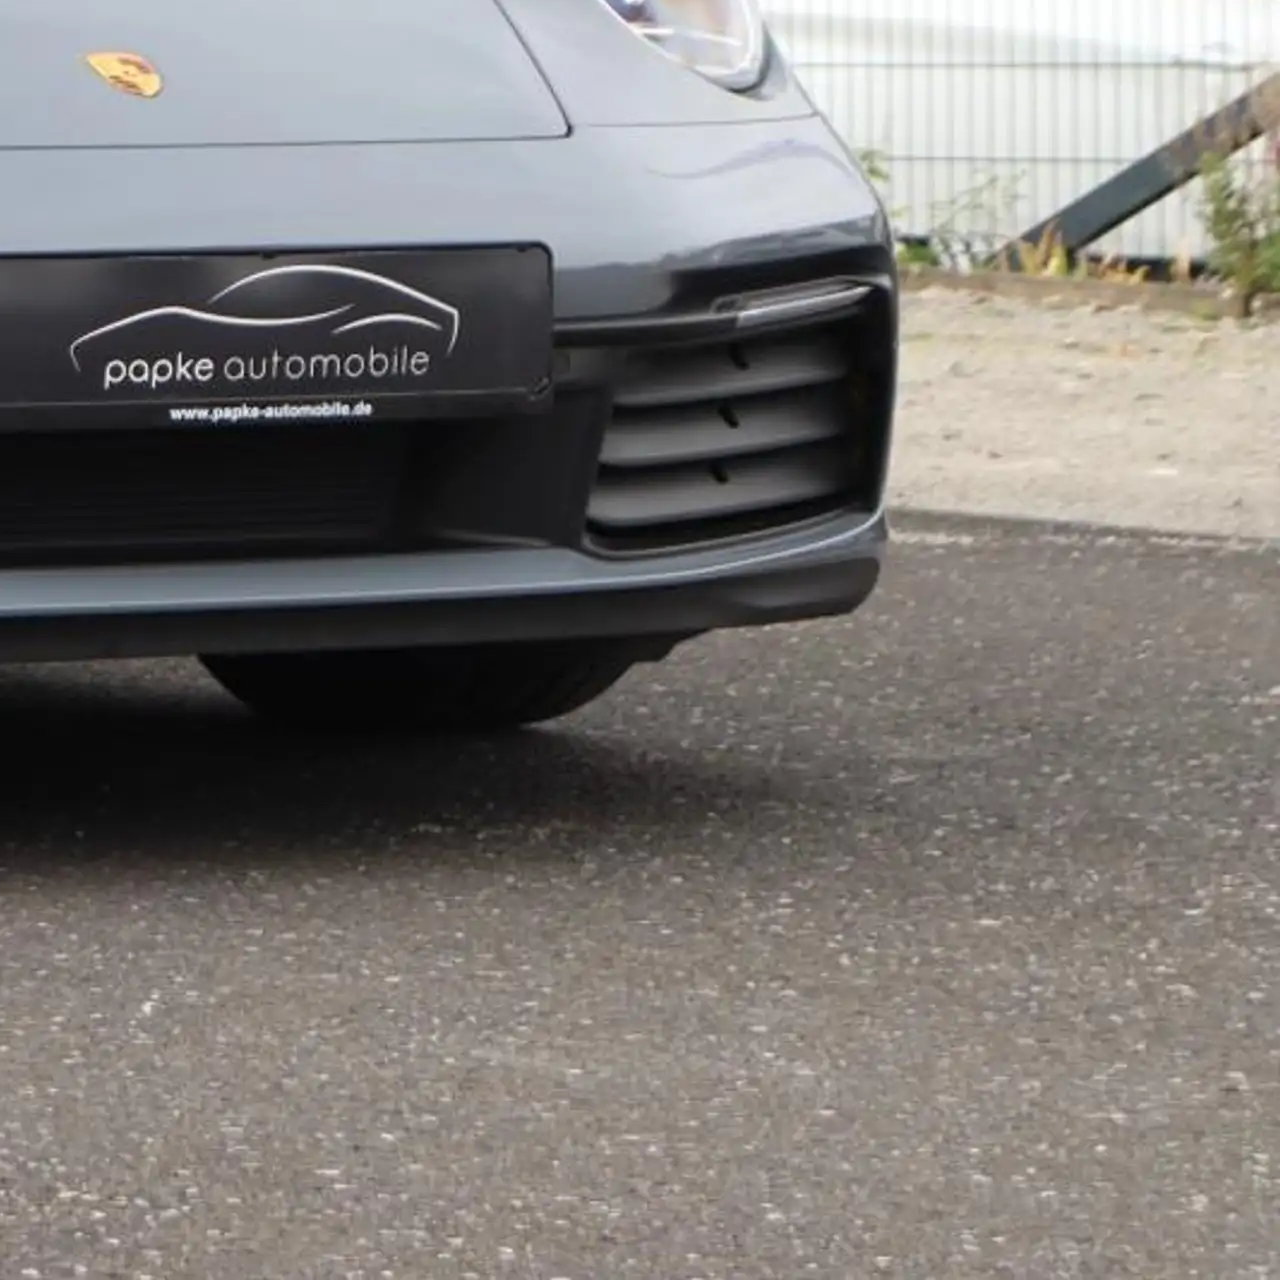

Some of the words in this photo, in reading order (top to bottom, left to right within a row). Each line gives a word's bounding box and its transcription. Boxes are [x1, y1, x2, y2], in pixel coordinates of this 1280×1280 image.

[104, 351, 215, 390] papke
[224, 345, 430, 380] automobile
[169, 401, 373, 423] www.papke-automobile.de
